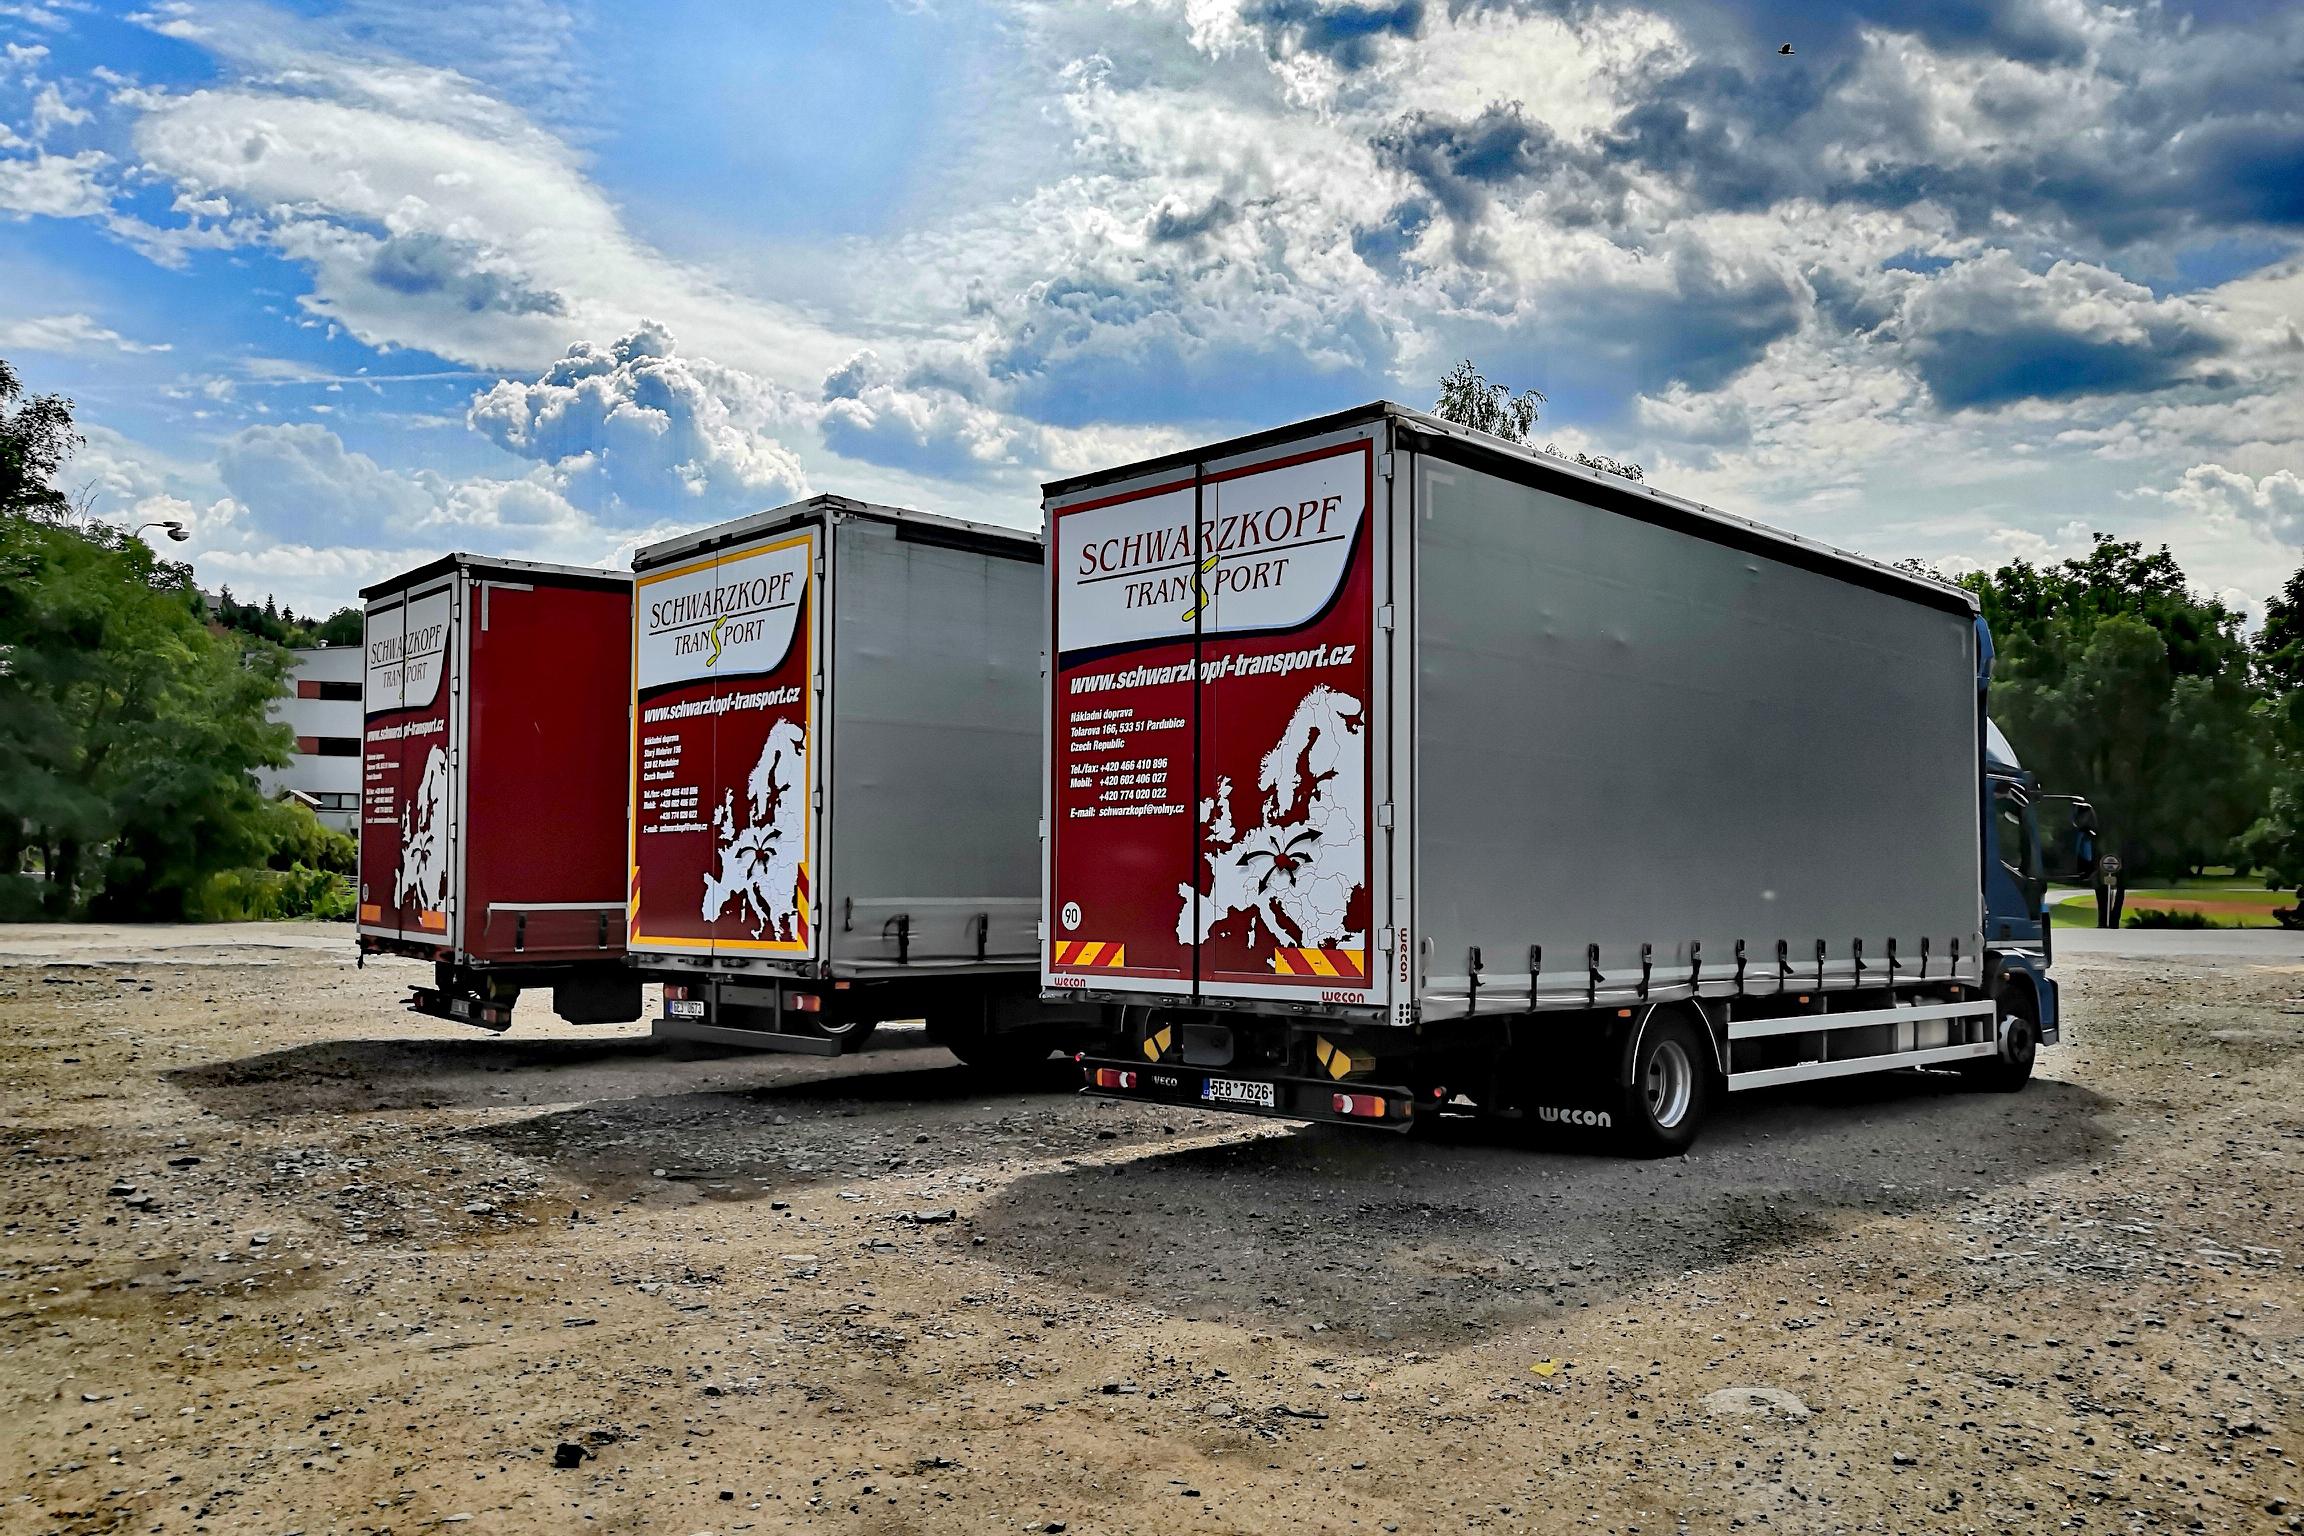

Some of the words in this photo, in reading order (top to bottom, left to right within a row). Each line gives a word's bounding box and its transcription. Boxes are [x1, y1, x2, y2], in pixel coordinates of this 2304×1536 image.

[1079, 495, 1342, 575] SCHWARZKOPF
[1125, 554, 1289, 622] TRANSPORT
[651, 571, 794, 629] SCHWARZKOPF
[675, 614, 766, 668] TRANSPORT
[383, 661, 428, 690] TRANPORT
[1070, 644, 1355, 694] www.schwarzkopf-transport.cz
[644, 685, 800, 723] www.schwarzkopf-transport.cz
[1103, 708, 1133, 720] doprava
[1071, 726, 1100, 737] Tolarova
[1102, 723, 1118, 735] 166,
[1119, 722, 1134, 733] 533
[1135, 721, 1145, 731] 51
[1146, 718, 1185, 731] Pardubice
[1070, 741, 1092, 752] Czech
[1093, 738, 1125, 751] Republic
[1070, 763, 1099, 774] Tel./fax:
[1100, 761, 1119, 772] +420
[1120, 760, 1135, 771] 466
[1136, 759, 1151, 769] 410
[1153, 758, 1168, 768] 896
[1070, 777, 1092, 788] Mobil:
[1099, 775, 1119, 786] +420
[1120, 774, 1135, 785] 602
[1136, 773, 1151, 784] 406
[1152, 772, 1167, 783] 027
[1099, 791, 1119, 801] +420
[1120, 790, 1134, 800] 774
[1136, 789, 1150, 799] 020
[1152, 788, 1167, 798] 022
[1070, 807, 1096, 818] E-mail:
[1099, 803, 1184, 817] schwarzkopf@volny.cz
[1065, 908, 1078, 923] 90
[1400, 927, 1408, 983] wecon
[1054, 976, 1086, 988] wecon
[1322, 990, 1365, 1003] wecon
[1211, 1080, 1232, 1097] 5E8
[1240, 1082, 1269, 1100] 7626
[1538, 1106, 1612, 1128] wecon
